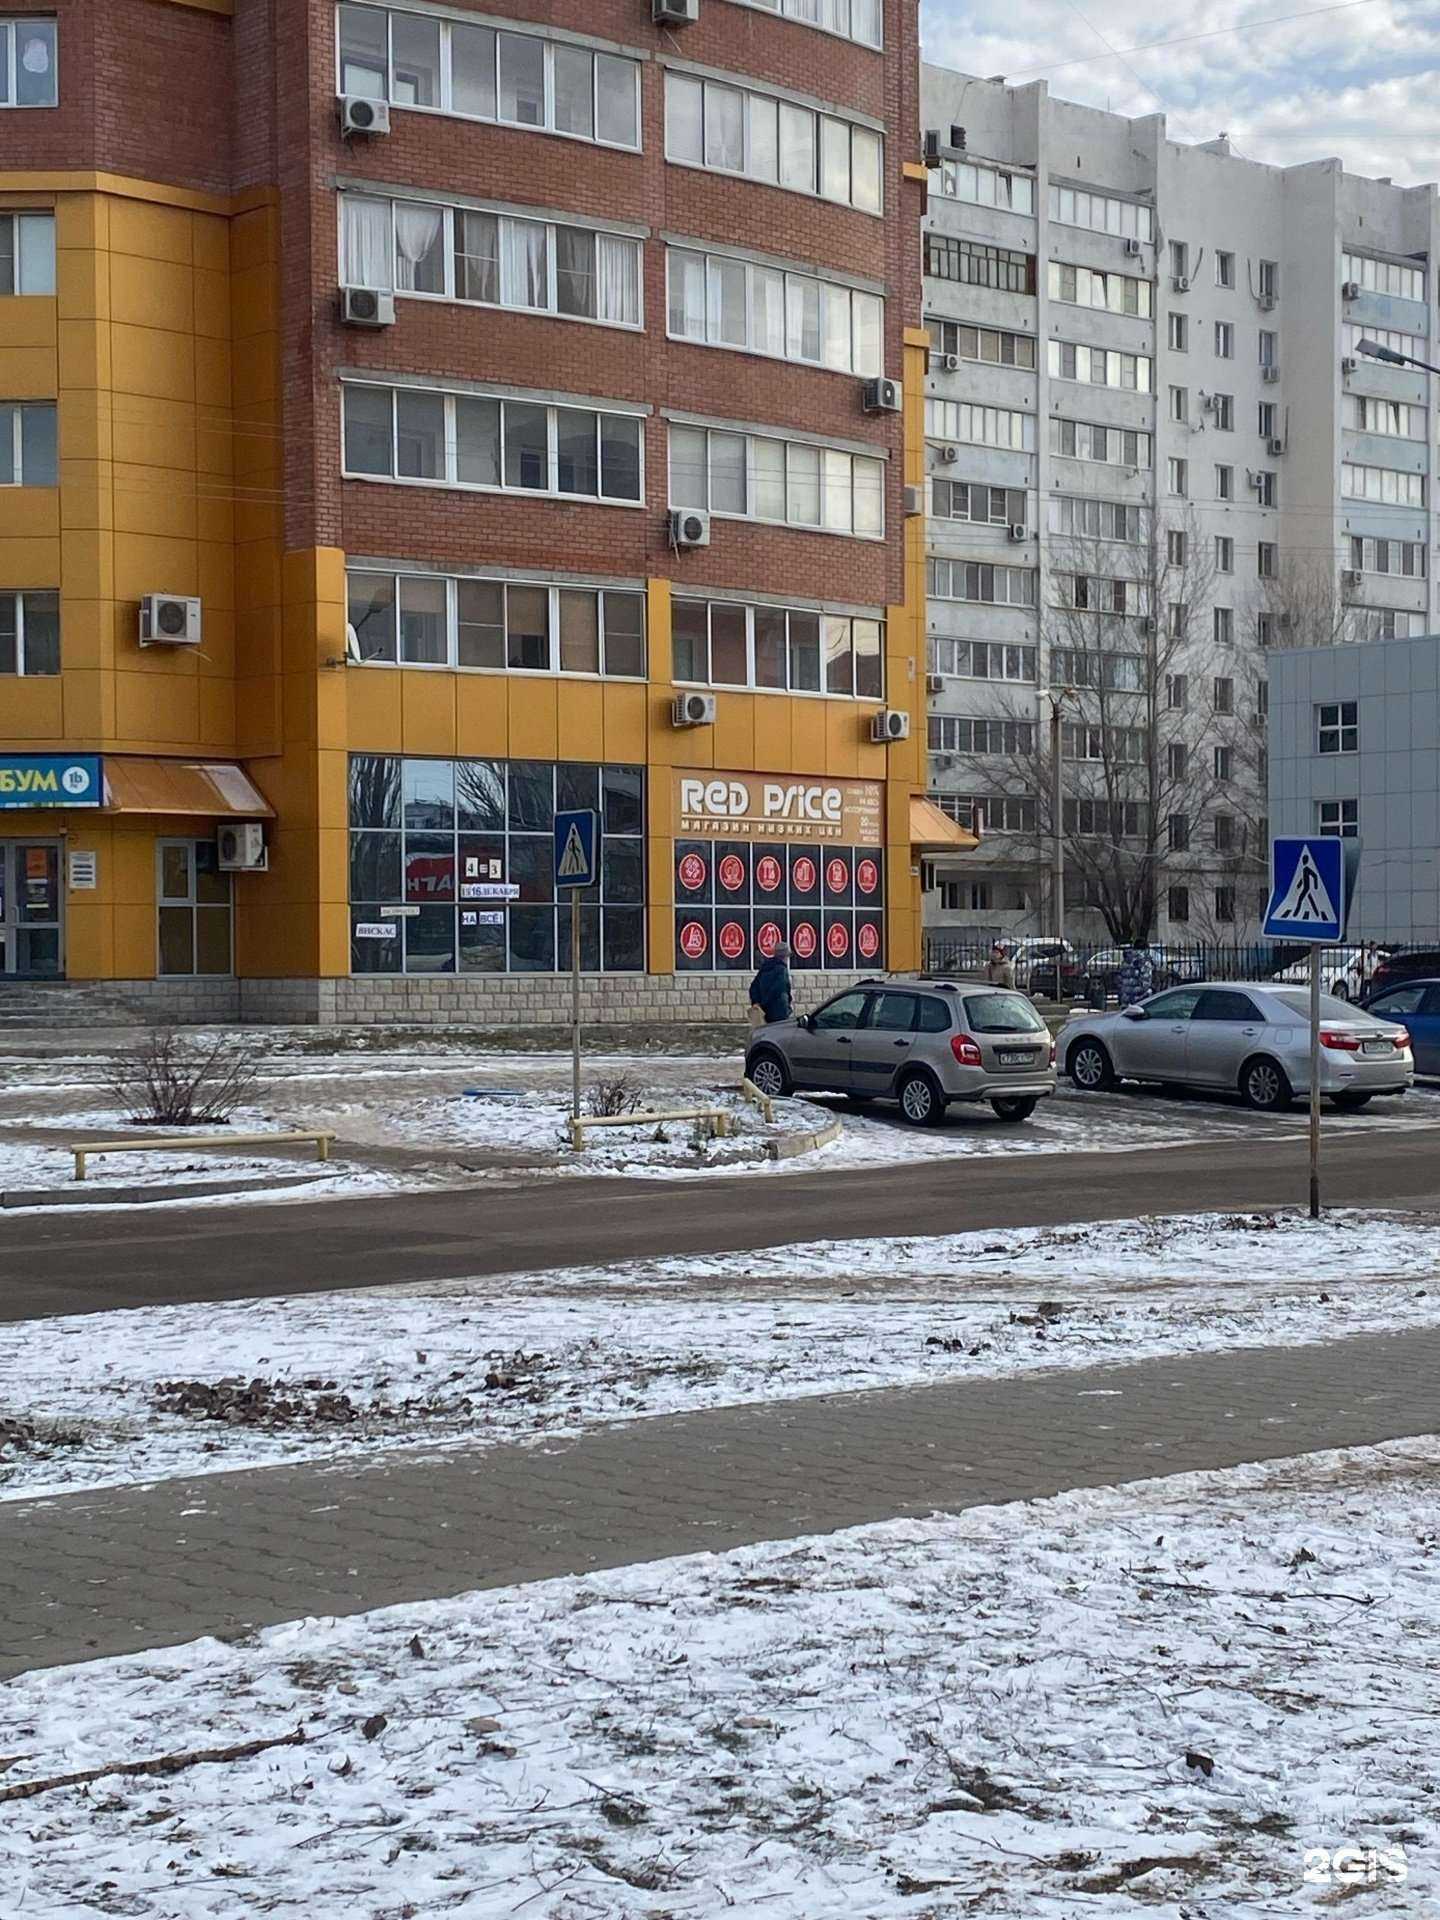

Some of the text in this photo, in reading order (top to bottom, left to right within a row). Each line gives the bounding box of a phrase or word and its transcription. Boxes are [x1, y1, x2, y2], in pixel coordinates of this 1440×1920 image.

[681, 820, 842, 838] МАГАЗИН НИЗКИХ ЦЕН
